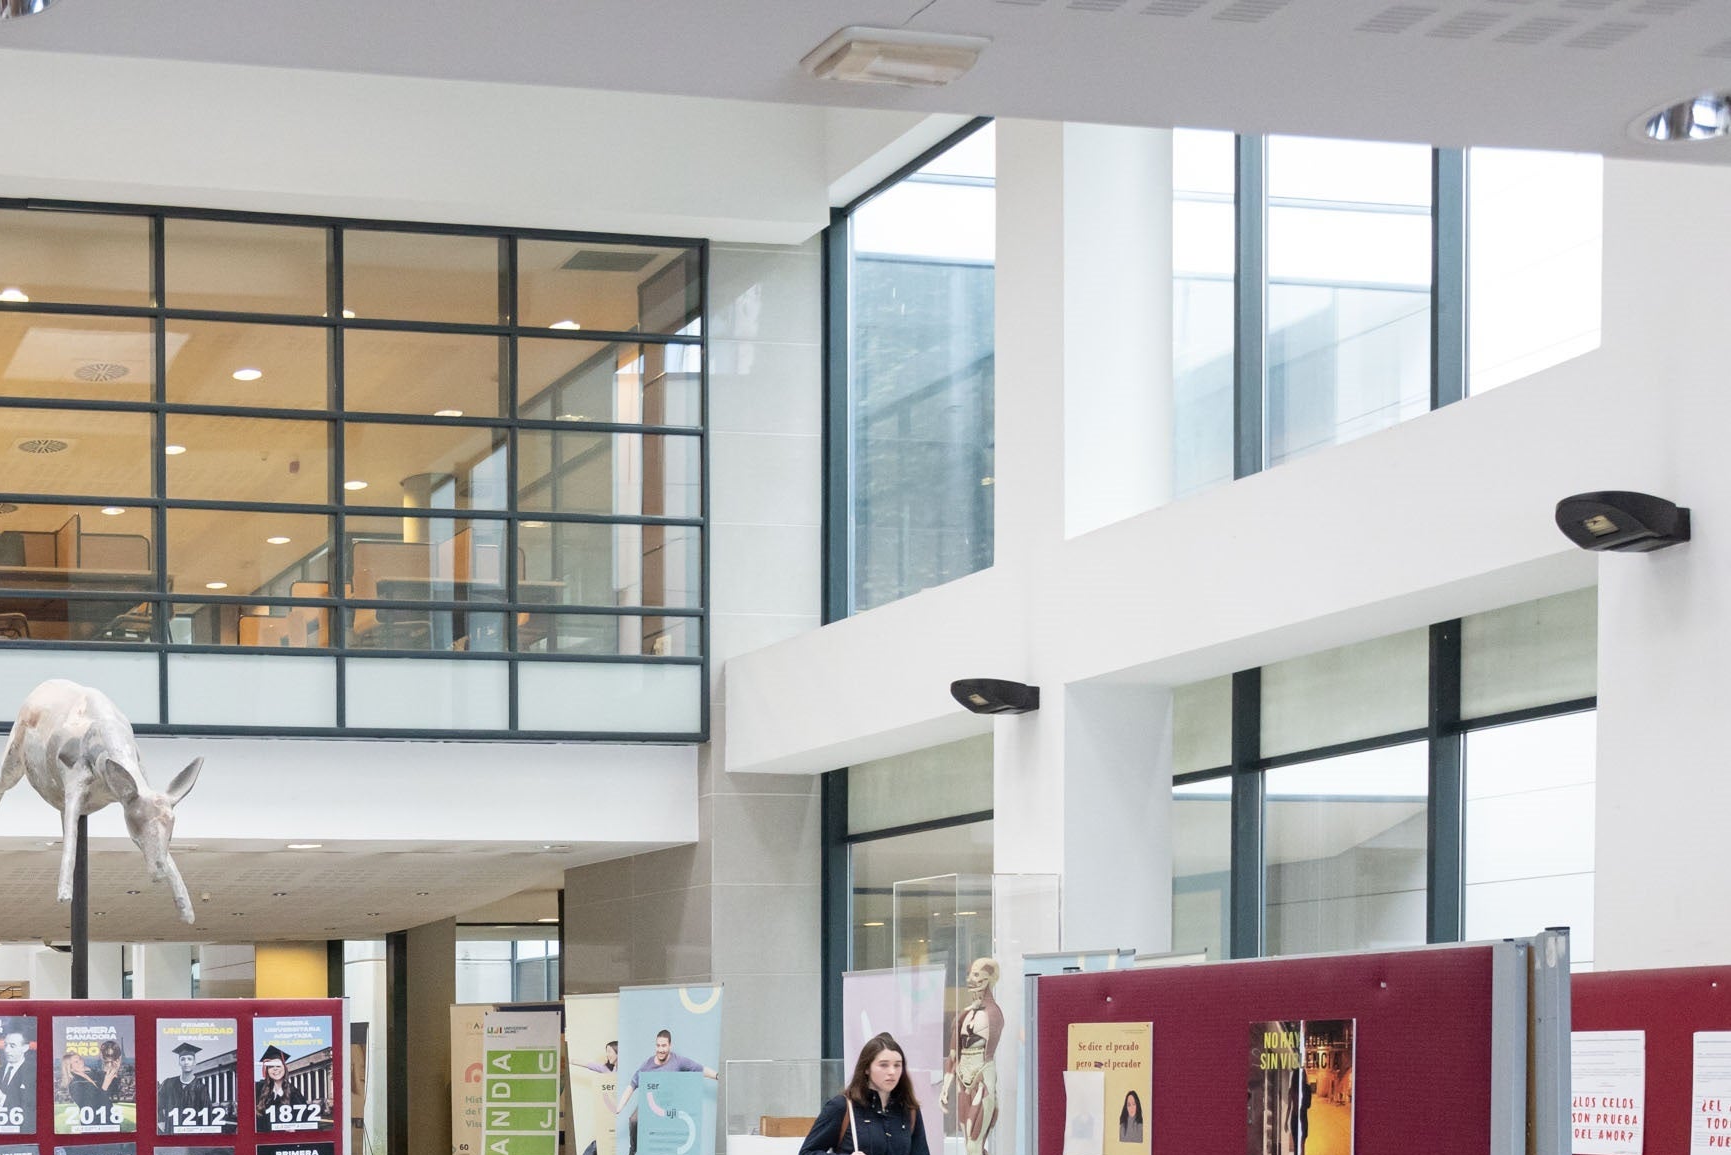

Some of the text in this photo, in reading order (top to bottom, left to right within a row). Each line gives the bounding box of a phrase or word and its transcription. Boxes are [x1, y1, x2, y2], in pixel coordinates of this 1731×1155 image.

[65, 1026, 117, 1034] PRIMERA
[162, 1027, 234, 1035] UNIVERSIDAD
[65, 1033, 117, 1041] GANADORA
[177, 1033, 219, 1041] ESPAÑOLA
[1264, 1032, 1278, 1049] NO
[1280, 1032, 1300, 1049] HAY
[1078, 1041, 1140, 1053] Se dice el pecado
[1076, 1060, 1141, 1070] pero el pecador
[1260, 1053, 1278, 1070] SIN
[646, 1083, 659, 1091] ser
[1572, 1096, 1635, 1110] ¿LOS CELOS
[1701, 1098, 1722, 1112] ¿EL
[65, 1106, 124, 1125] 2018
[168, 1107, 226, 1125] 1212
[266, 1104, 322, 1123] 1872
[666, 1109, 677, 1119] uji
[1572, 1112, 1639, 1126] SON PRUEBA
[1574, 1129, 1635, 1143] DEL AMOR?
[459, 1143, 469, 1151] 60
